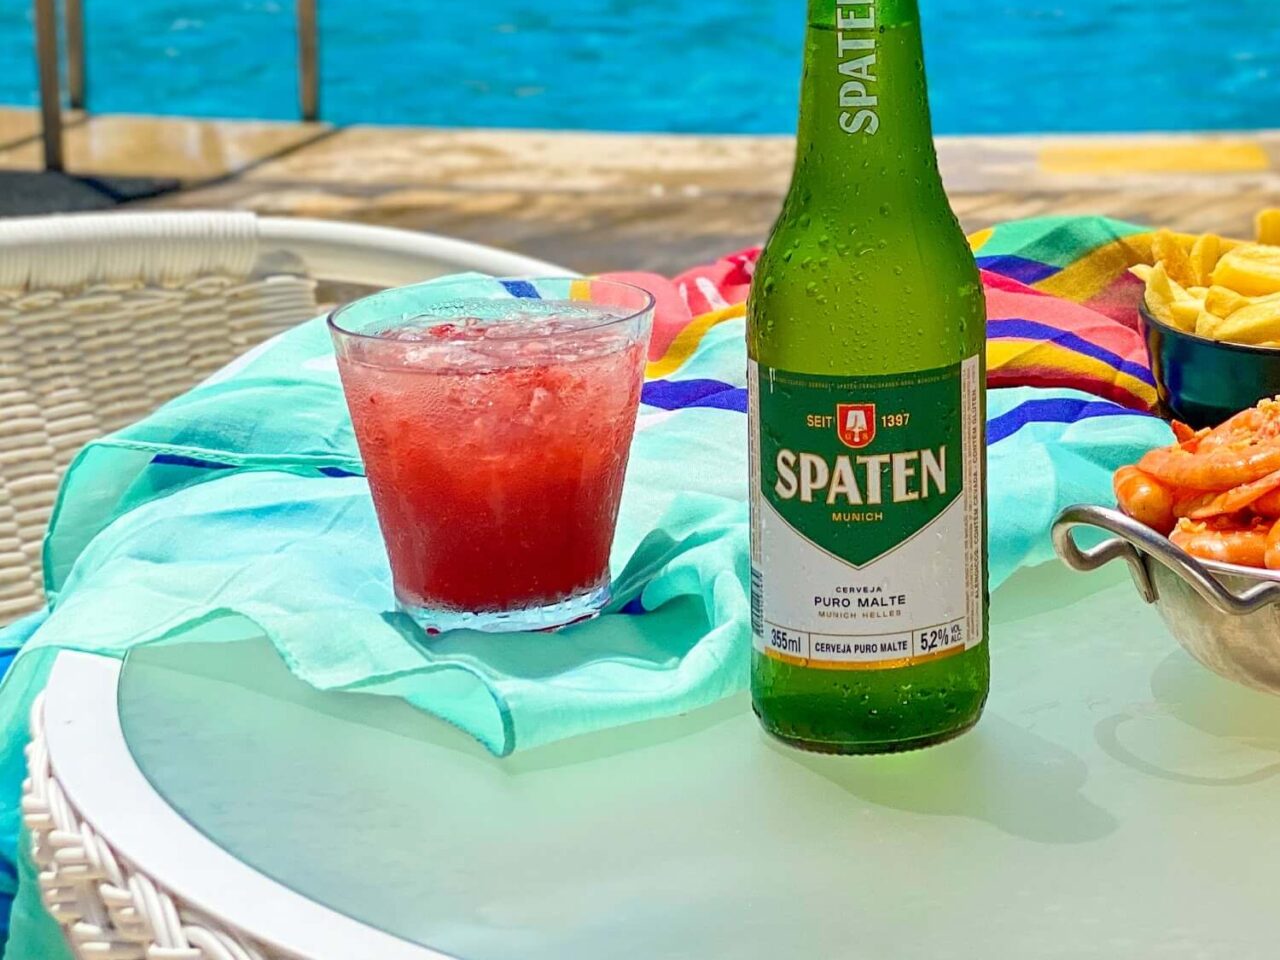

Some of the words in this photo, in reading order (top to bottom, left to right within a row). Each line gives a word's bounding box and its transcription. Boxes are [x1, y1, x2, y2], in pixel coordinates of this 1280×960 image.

[807, 413, 832, 428] SEIT
[881, 413, 910, 427] 1397
[774, 445, 947, 506] SPATEN
[832, 511, 883, 522] MUNICH
[836, 586, 882, 594] CERVEJA
[814, 596, 851, 608] PURO
[857, 595, 906, 607] MALTE
[819, 611, 857, 619] MUNICH
[862, 610, 902, 618] HELLES
[771, 628, 801, 653] 355ml
[815, 642, 852, 653] CERVEJA
[854, 643, 878, 653] PURO
[880, 641, 908, 652] MALTE
[921, 628, 949, 652] 5,2%
